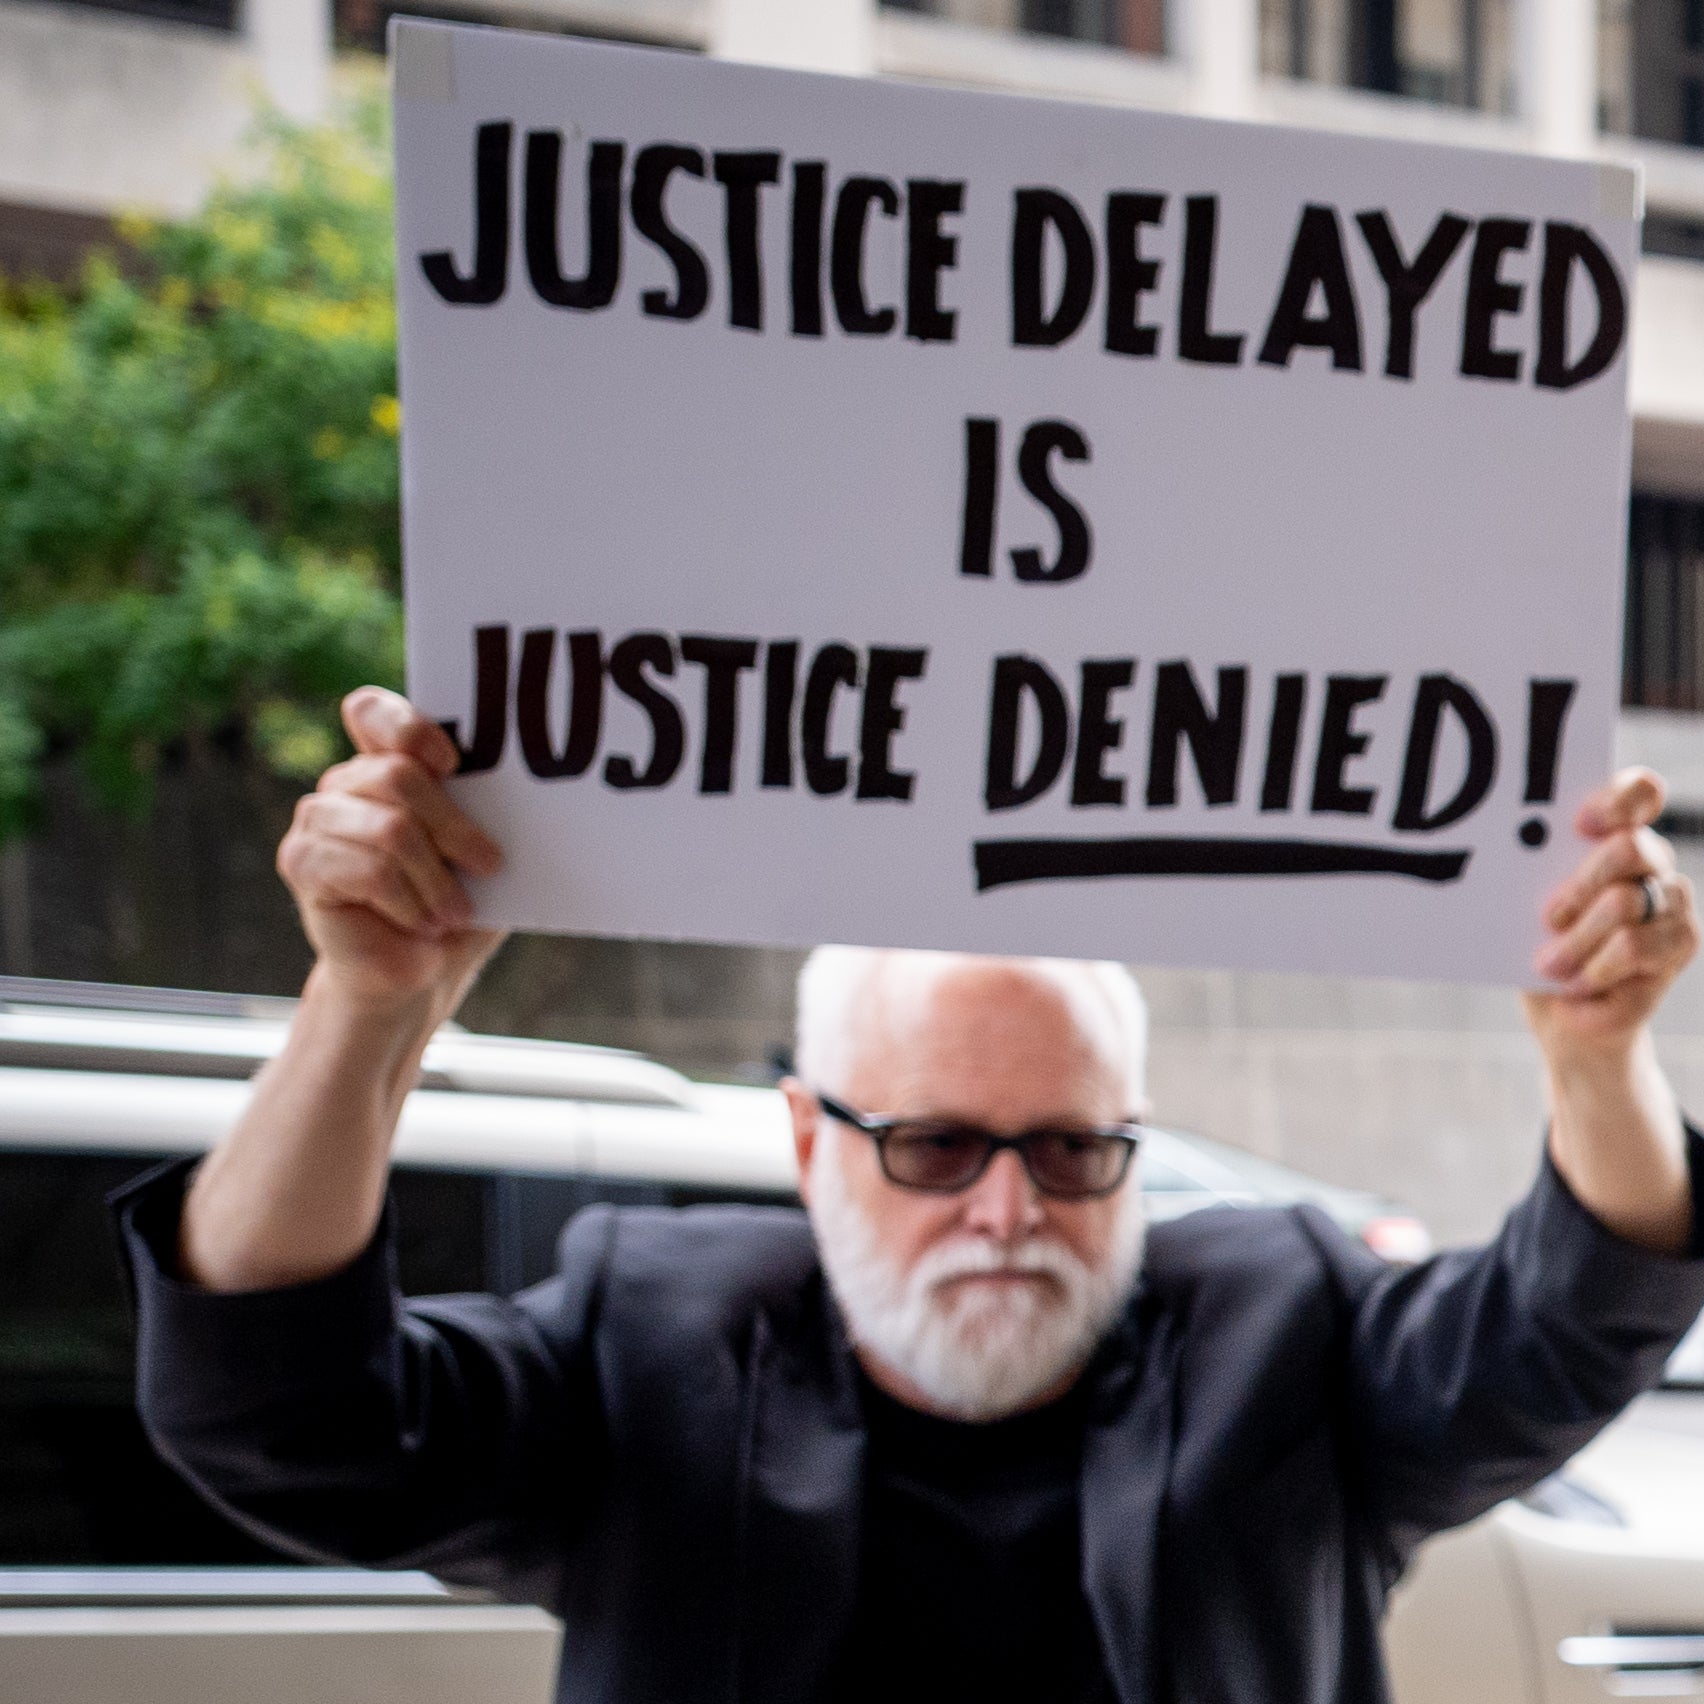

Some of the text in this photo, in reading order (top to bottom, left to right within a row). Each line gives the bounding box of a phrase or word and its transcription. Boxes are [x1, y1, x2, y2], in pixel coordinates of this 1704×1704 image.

[418, 119, 1629, 392] JUSTICE DELAYED
[958, 416, 1094, 585] IS
[437, 624, 1579, 849] JUSTICE DENIED!
